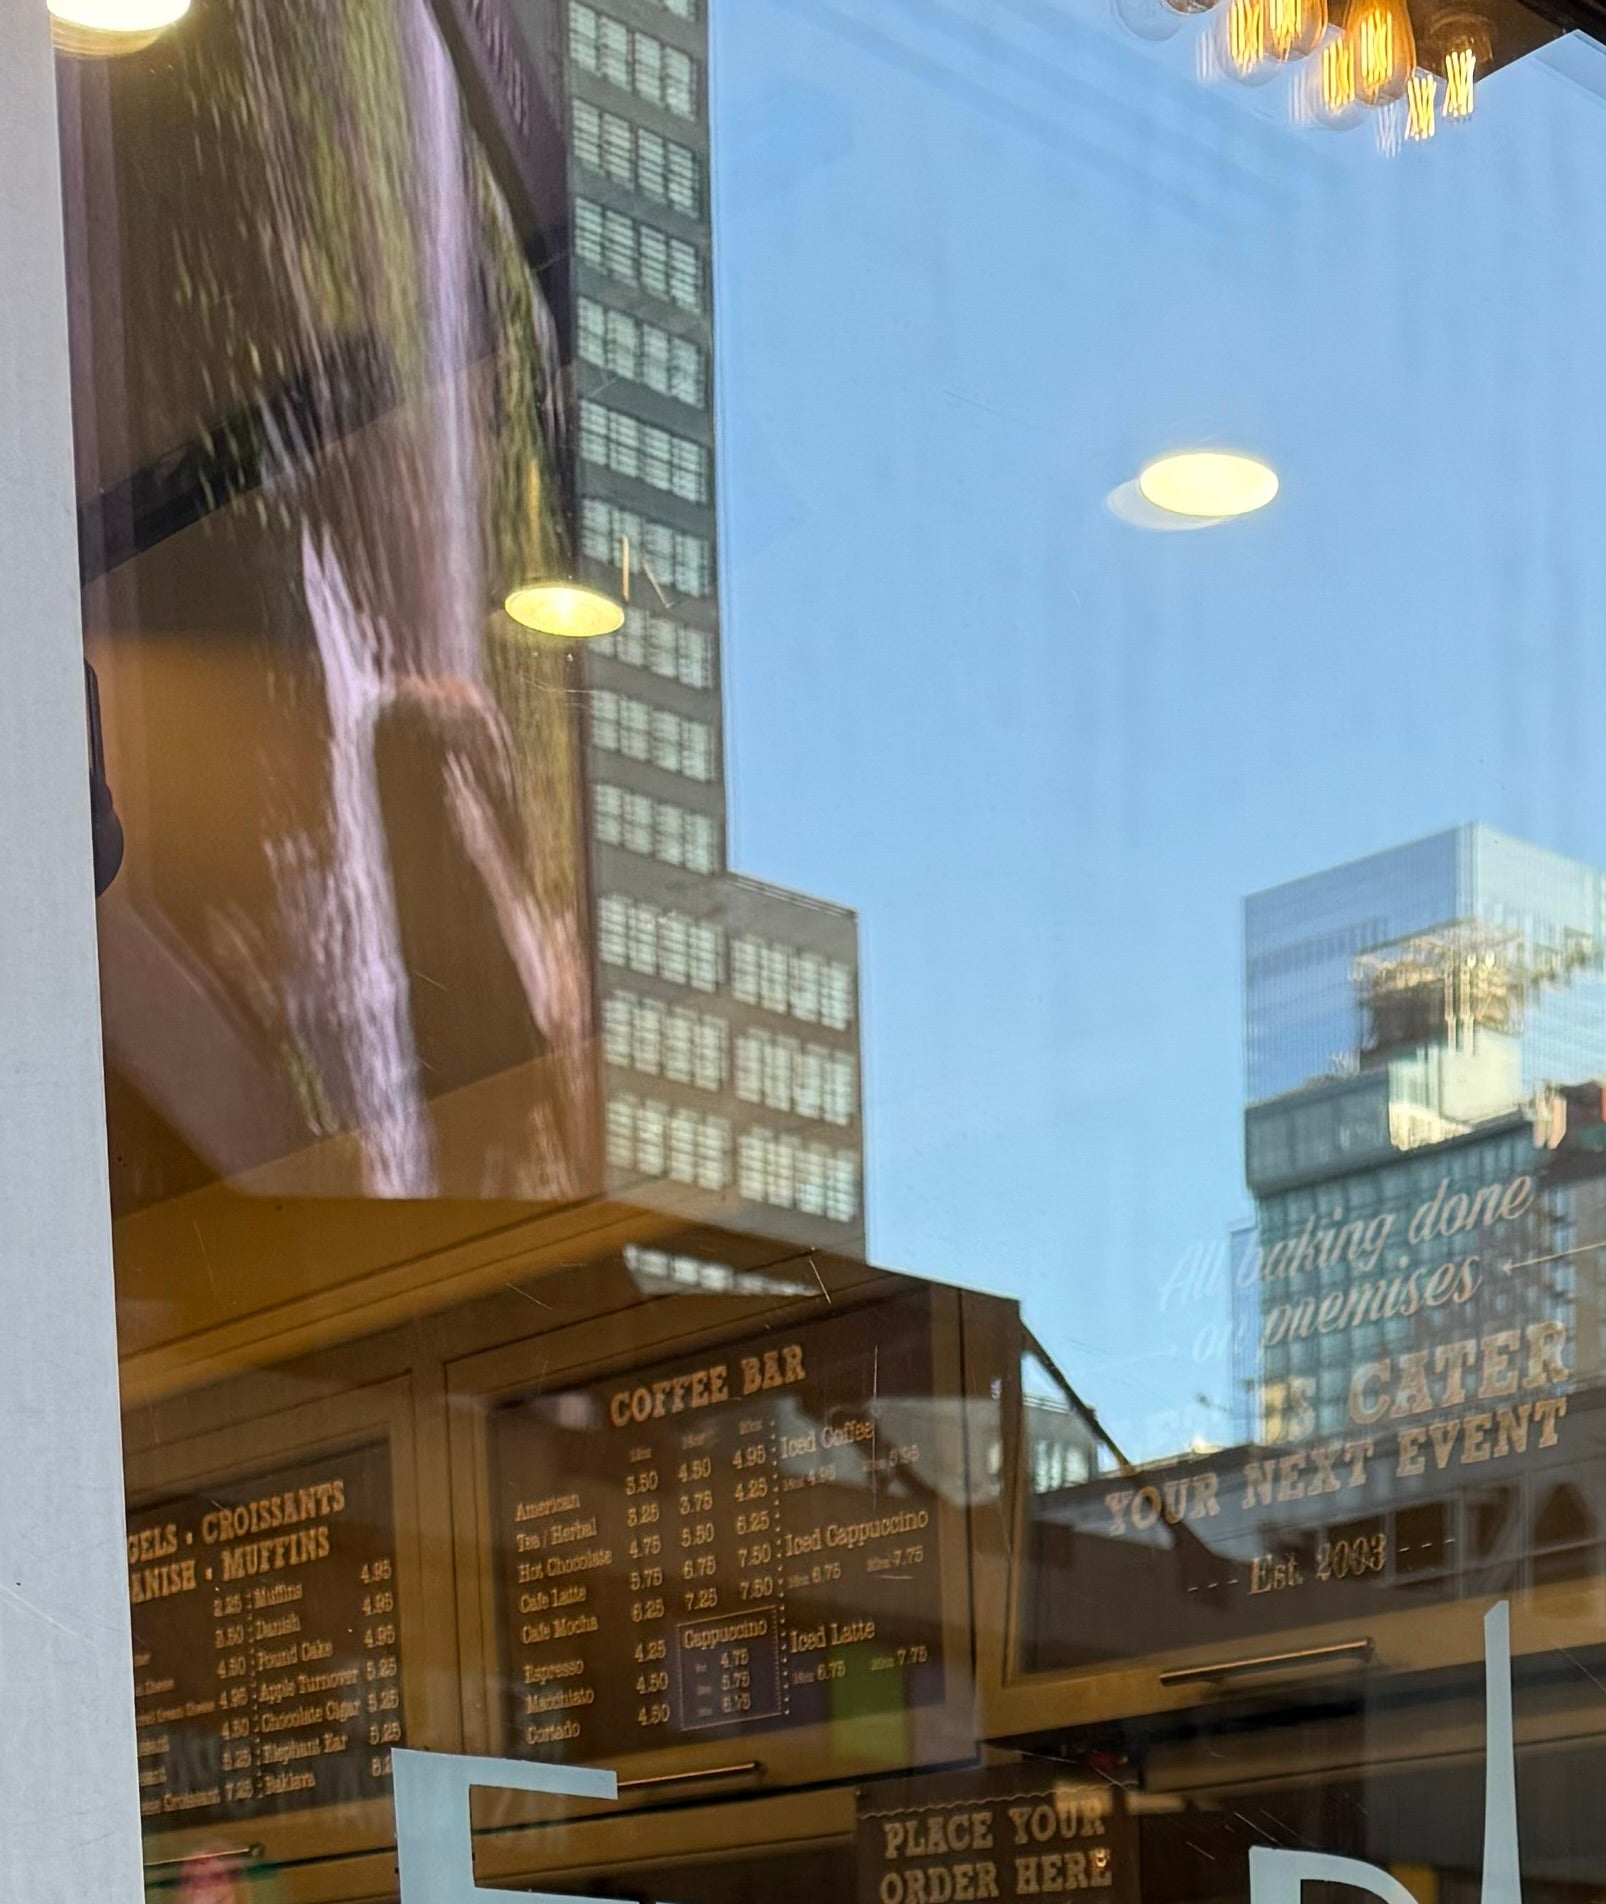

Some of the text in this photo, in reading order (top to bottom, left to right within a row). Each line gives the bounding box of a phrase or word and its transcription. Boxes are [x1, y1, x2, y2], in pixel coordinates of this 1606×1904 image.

[1236, 1206, 1395, 1288] baking
[1408, 1175, 1536, 1245] done
[1257, 1255, 1483, 1358] premises
[610, 1345, 806, 1428] COFFEE BAR
[1348, 1321, 1570, 1426] CATER
[781, 1420, 874, 1459] Iced Coffee
[1104, 1397, 1568, 1536] YOUR NEXT EVENT
[202, 1480, 346, 1545] CROISSANTS
[785, 1510, 929, 1557] Iced Cappuccino
[222, 1526, 330, 1582] MUFFINS
[518, 1563, 545, 1584] Hot
[547, 1549, 613, 1577] Chocolate
[1249, 1553, 1303, 1595] Est.
[684, 1618, 768, 1650] Cappuccino
[790, 1618, 875, 1654] Iced Latte
[884, 1799, 1105, 1860] PLACE YOUR
[1016, 1848, 1112, 1895] HERE
